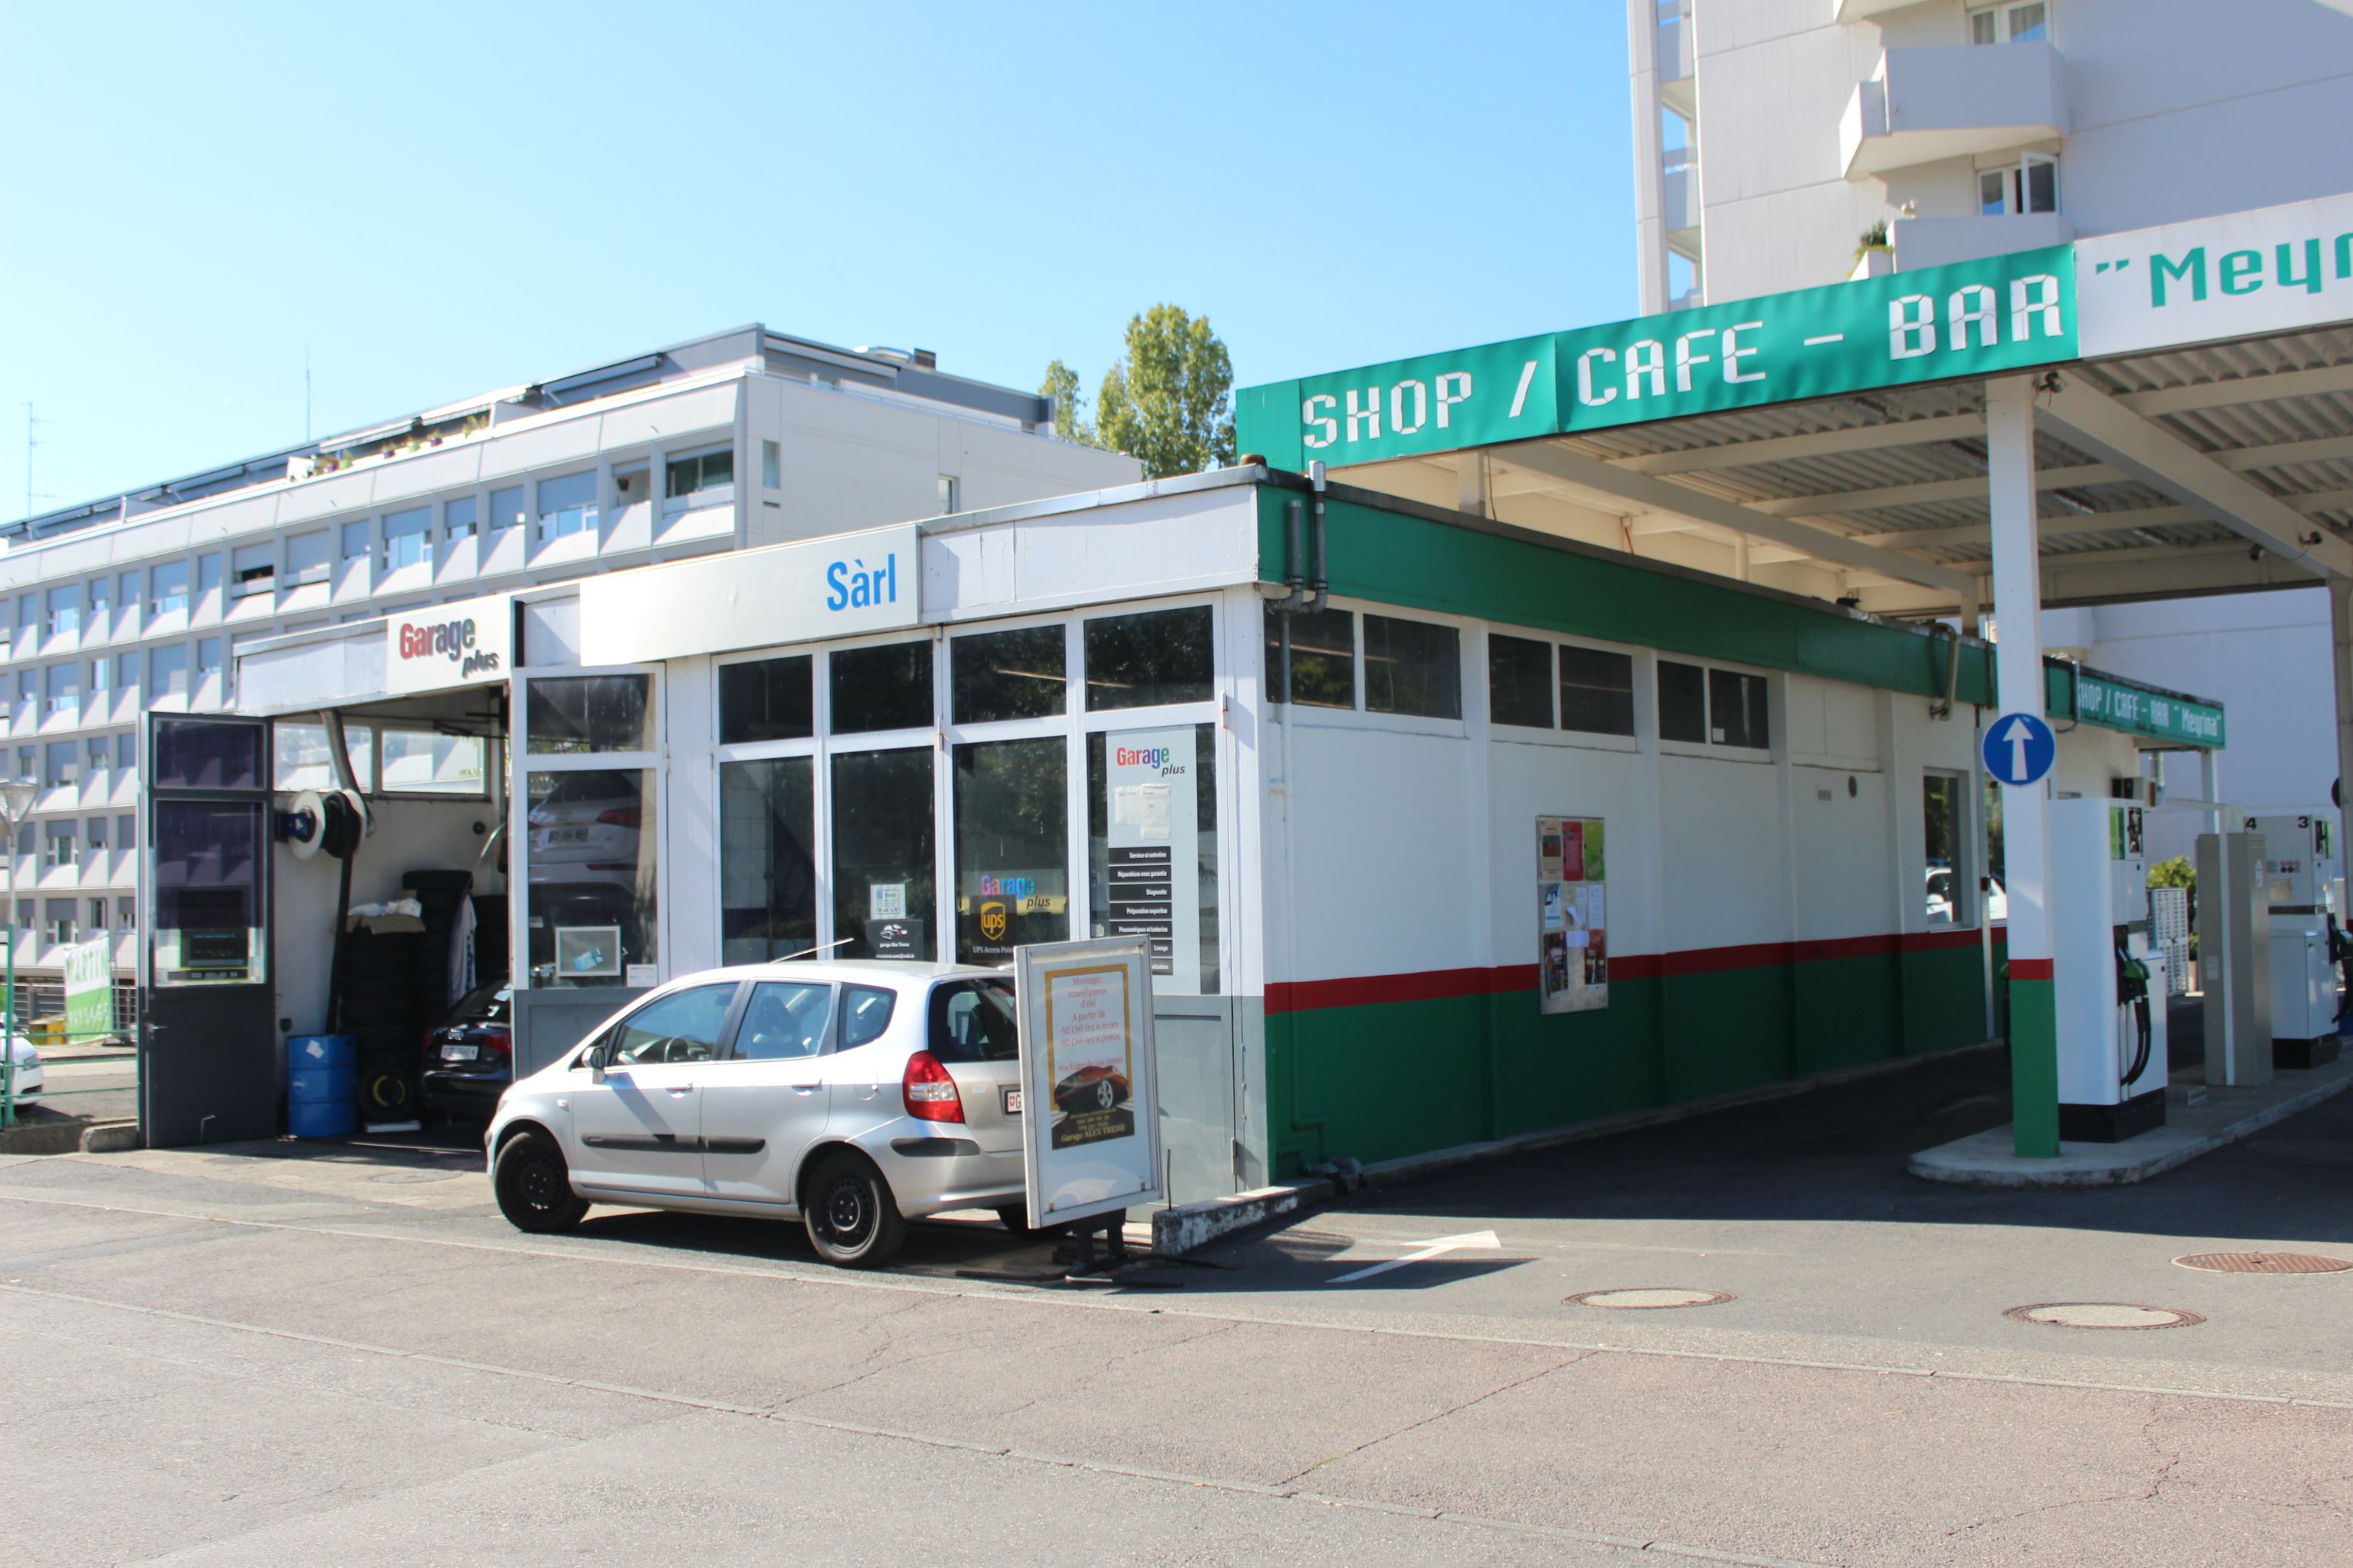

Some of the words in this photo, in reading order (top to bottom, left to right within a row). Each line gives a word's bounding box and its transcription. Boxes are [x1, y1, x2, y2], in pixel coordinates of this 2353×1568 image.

[1303, 371, 1472, 449] SHOP
[1508, 360, 1538, 419] /
[1577, 320, 1766, 407] CAFE
[1888, 274, 2064, 361] BAR
[826, 552, 898, 613] Sàrl
[399, 615, 476, 661] Garage
[462, 648, 500, 680] plus
[2115, 691, 2139, 721] CAFE
[2151, 701, 2169, 727] BAR
[1116, 747, 1170, 769] Garage
[1162, 764, 1186, 777] plus
[2245, 817, 2257, 830] 4
[2297, 816, 2308, 829] 3
[981, 874, 1035, 901] Garage
[1027, 895, 1051, 909] plus
[983, 914, 1004, 934] ups
[1078, 1011, 1096, 1023] partir
[1098, 1009, 1106, 1019] de
[1072, 1024, 1085, 1034] CHF
[1085, 1024, 1095, 1032] les
[1102, 1021, 1119, 1030] roues
[1085, 1036, 1095, 1044] les
[1102, 1034, 1121, 1043] pneus
[1061, 1133, 1083, 1143] Garage
[1084, 1129, 1102, 1138] ALEX
